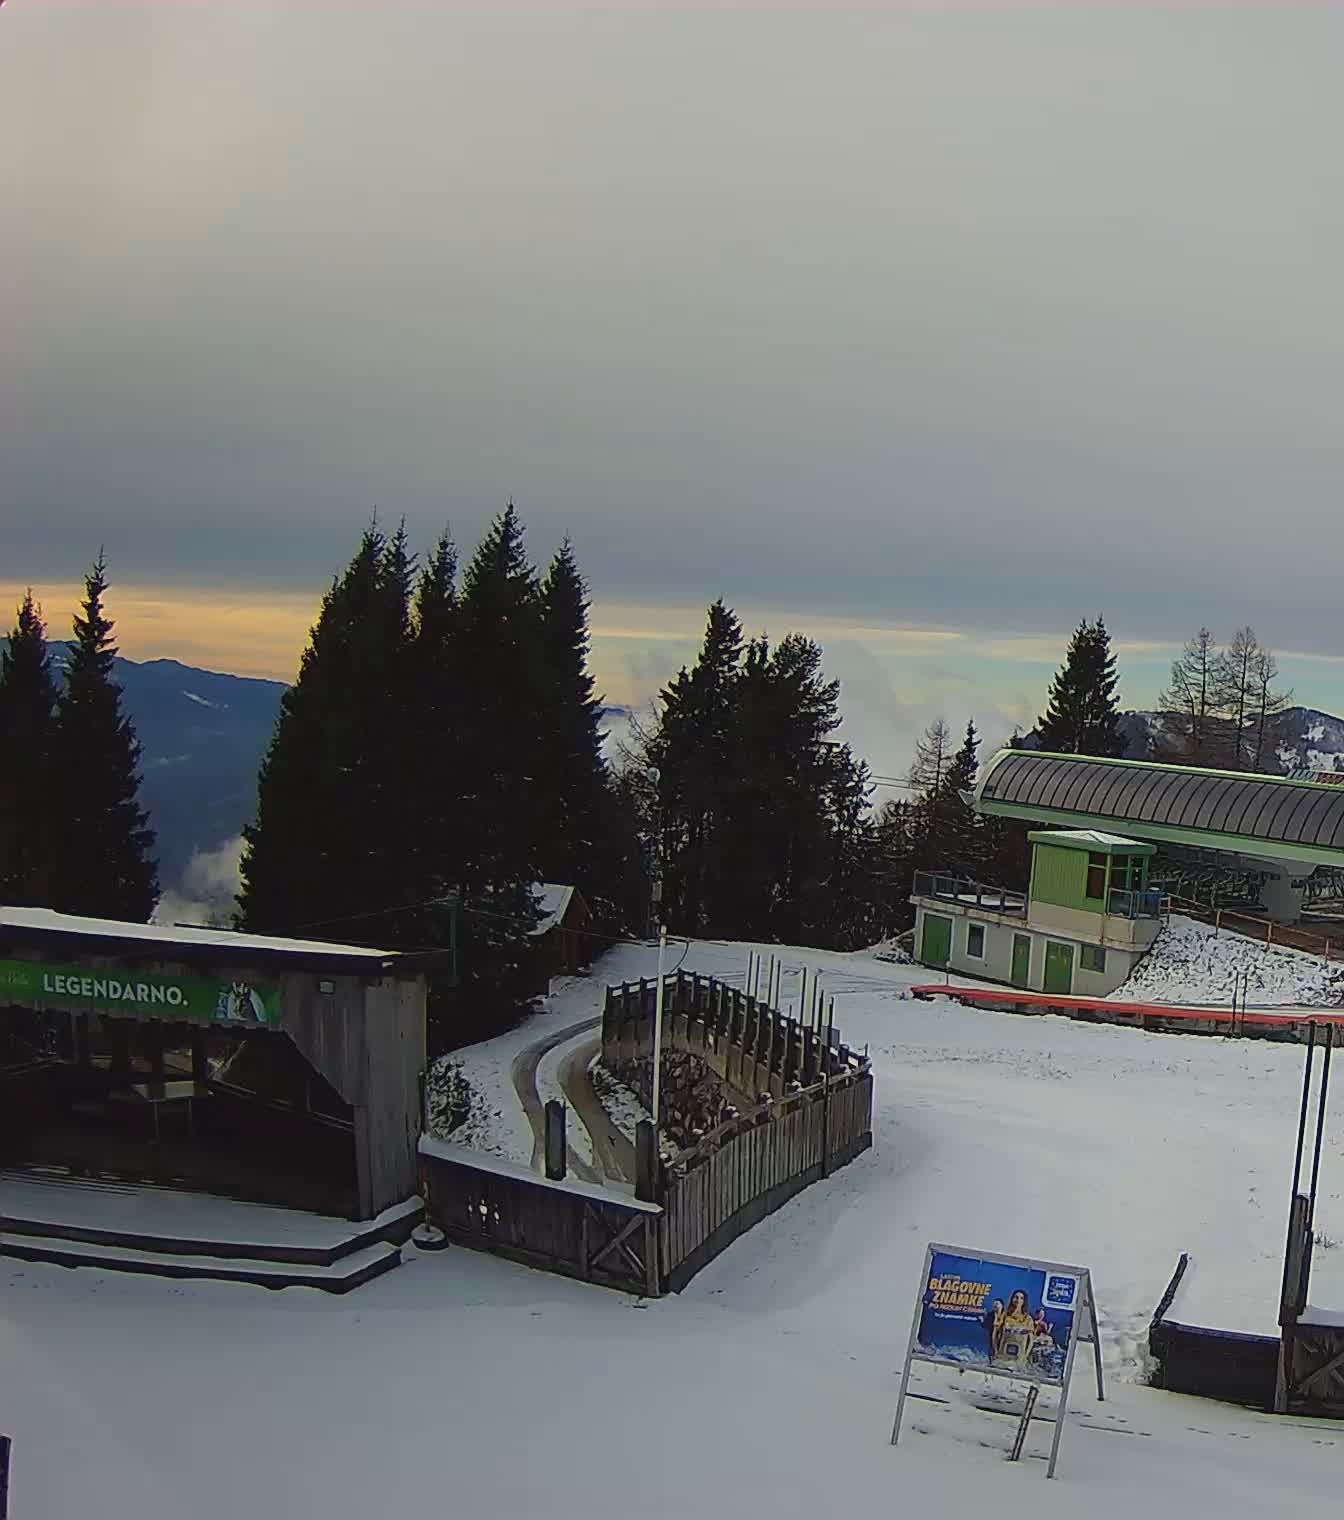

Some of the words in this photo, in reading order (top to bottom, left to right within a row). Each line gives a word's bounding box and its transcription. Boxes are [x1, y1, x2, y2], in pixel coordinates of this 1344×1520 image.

[42, 973, 189, 1006] LEGENDARNO.
[929, 1278, 992, 1296] BLAGOVNE
[932, 1290, 985, 1307] ZNAMKE
